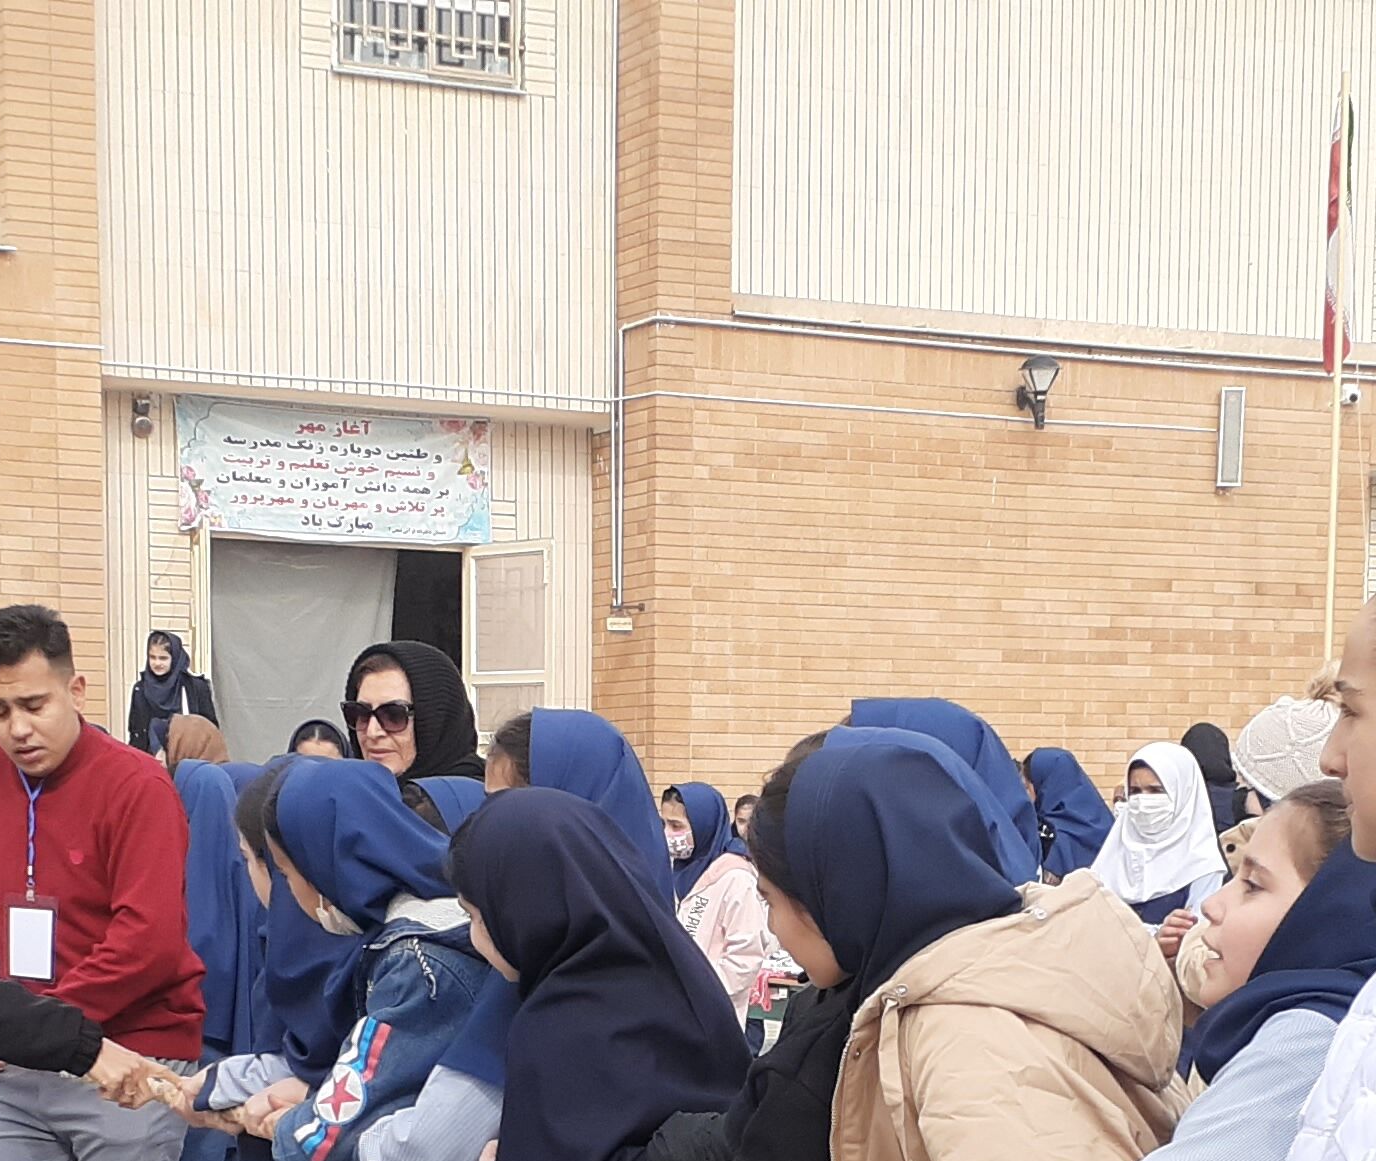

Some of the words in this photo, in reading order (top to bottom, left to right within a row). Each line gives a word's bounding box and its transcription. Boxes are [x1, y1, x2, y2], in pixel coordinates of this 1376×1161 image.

[295, 422, 326, 434] مهر
[332, 419, 372, 438] آغاز
[223, 435, 282, 450] مدرسه
[329, 443, 382, 459] دوباره
[386, 448, 428, 462] طنین
[223, 453, 272, 469] تربیت
[276, 460, 285, 471] و
[289, 457, 330, 471] تعلیم
[433, 453, 443, 464] و
[334, 462, 380, 477] خوش
[384, 465, 421, 479] نسیم
[426, 471, 436, 480] و
[216, 471, 272, 484] معلمان
[277, 479, 286, 489] و
[290, 477, 350, 492] آموزان
[354, 481, 397, 494] دانش
[402, 484, 432, 495] همه
[299, 498, 309, 509] و
[312, 496, 369, 512] مهربان
[374, 502, 383, 513] و
[386, 500, 426, 514] تلاش
[300, 513, 323, 531] باد
[326, 515, 374, 534] مبارک
